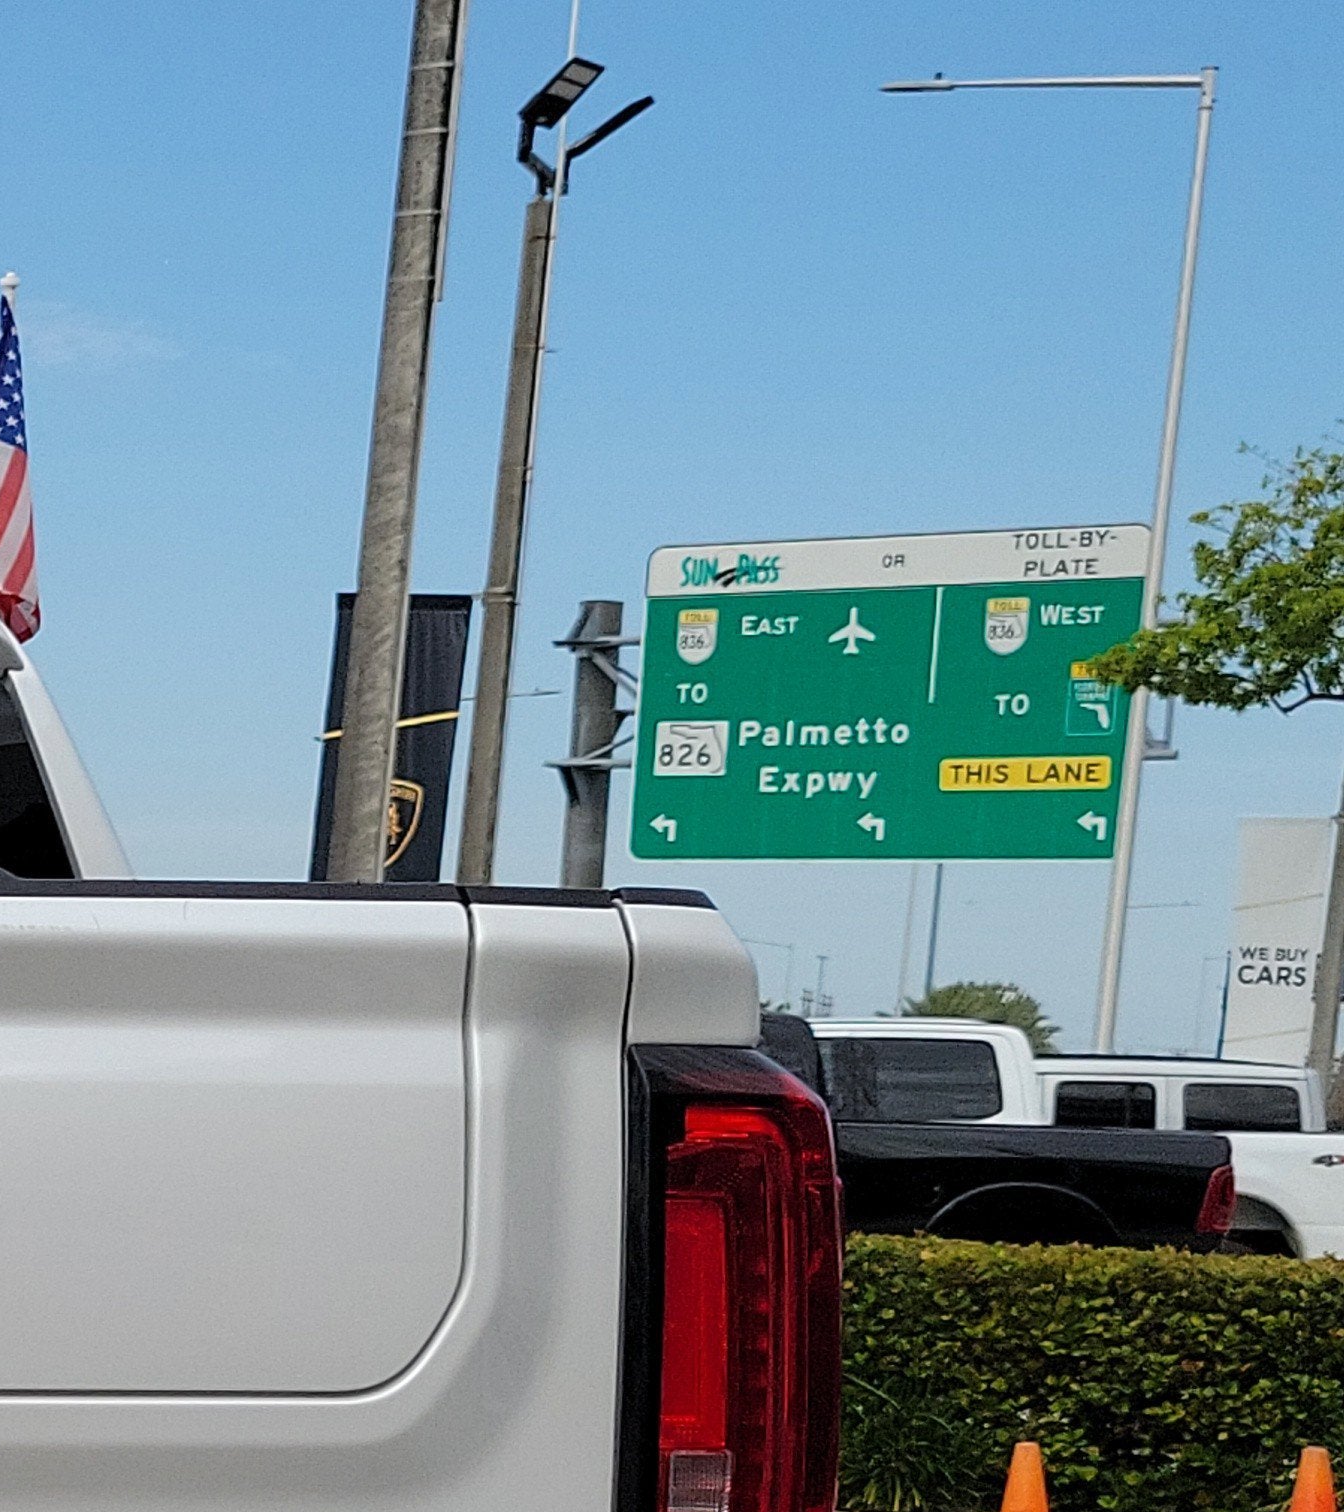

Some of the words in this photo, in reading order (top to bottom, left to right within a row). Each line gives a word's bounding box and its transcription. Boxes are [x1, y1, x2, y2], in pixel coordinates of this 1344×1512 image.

[882, 554, 906, 568] OR
[1023, 558, 1100, 577] PLATE
[741, 615, 799, 636] EAST
[1040, 603, 1105, 626] WEST
[679, 633, 704, 650] 836
[988, 624, 1014, 640] 836
[676, 683, 708, 704] TO
[994, 693, 1030, 716] TO
[738, 716, 910, 747] Palmetto
[658, 743, 712, 767] 826
[758, 766, 878, 798] Expwy
[948, 762, 1009, 785] THIS
[1025, 762, 1102, 784] LANE
[1239, 946, 1269, 961] WE
[1275, 948, 1308, 962] BUY
[1237, 964, 1307, 987] CARS
